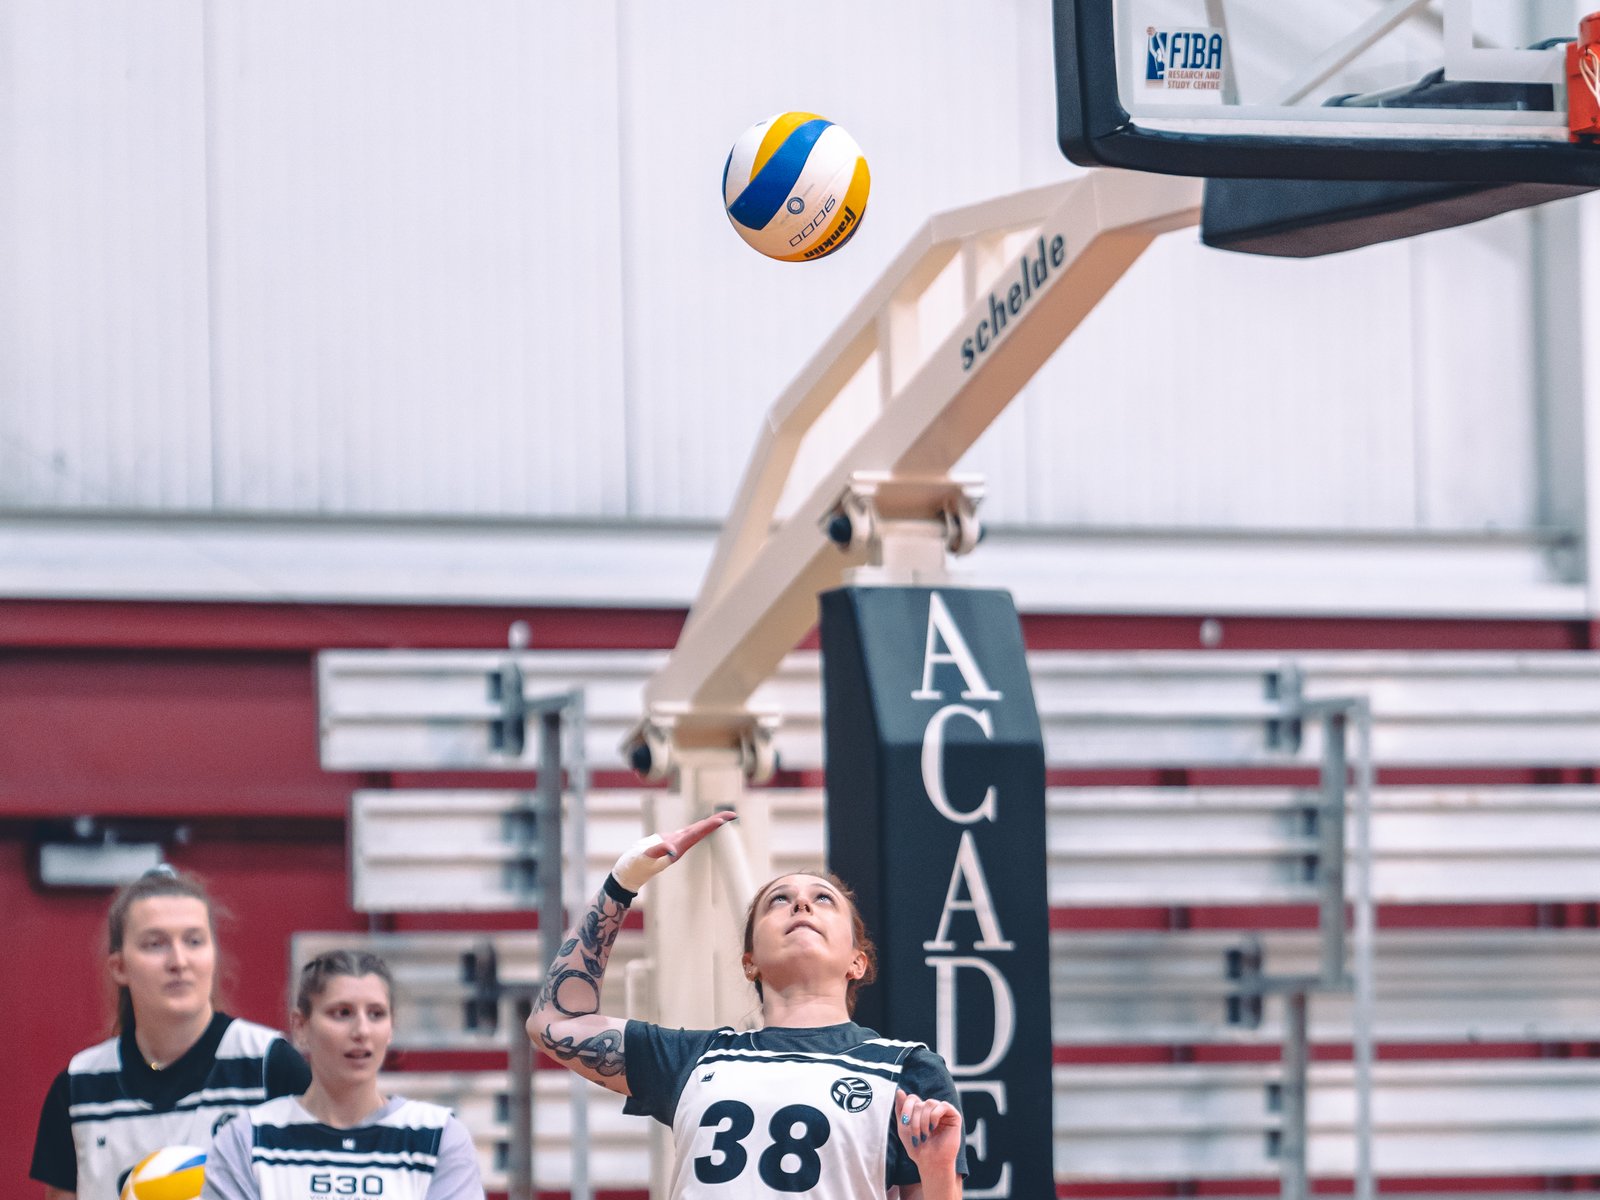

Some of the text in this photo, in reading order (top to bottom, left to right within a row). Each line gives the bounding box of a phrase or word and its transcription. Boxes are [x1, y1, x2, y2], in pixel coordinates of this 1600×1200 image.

[1168, 32, 1223, 69] FIBA
[1167, 70, 1220, 80] RESEARCH AND
[1167, 80, 1220, 90] STUDY CENTRE
[788, 194, 836, 247] 9000
[803, 206, 857, 258] franklin
[960, 233, 1065, 372] schelde
[694, 1099, 832, 1193] 38
[310, 1173, 384, 1195] 630
